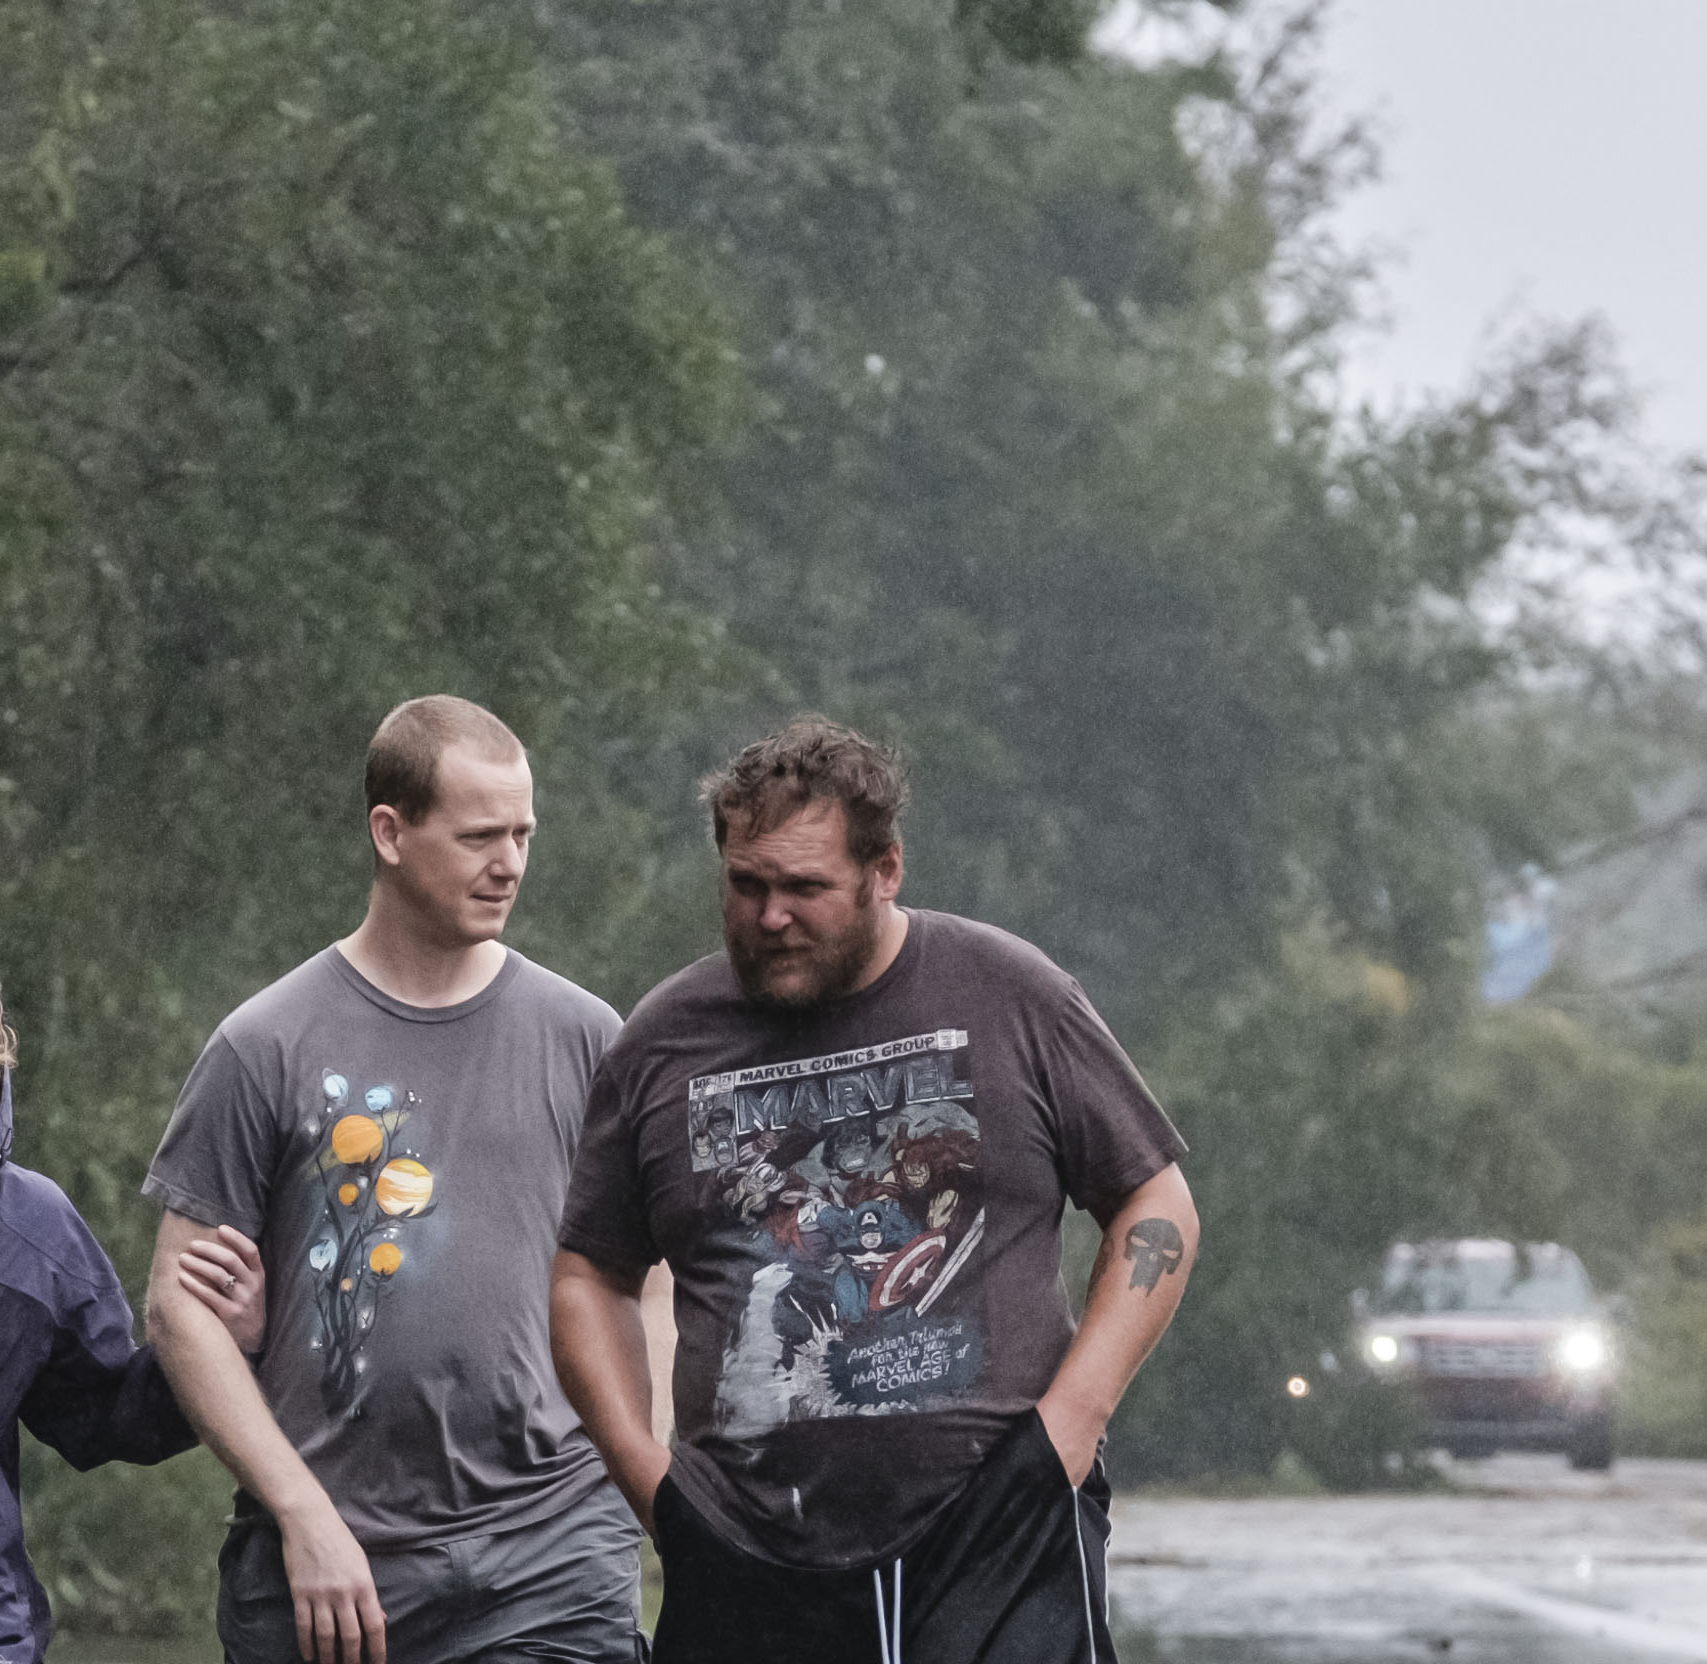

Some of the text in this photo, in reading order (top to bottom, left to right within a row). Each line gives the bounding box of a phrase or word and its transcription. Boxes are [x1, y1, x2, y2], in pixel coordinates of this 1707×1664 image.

[739, 1063, 805, 1082] MARVEL
[810, 1050, 877, 1072] COMICS
[881, 1036, 935, 1058] GROUP
[733, 1052, 974, 1135] MARVEL
[851, 1359, 913, 1388] MARVEL
[920, 1350, 952, 1369] AGE
[876, 1362, 951, 1393] COMICS!
